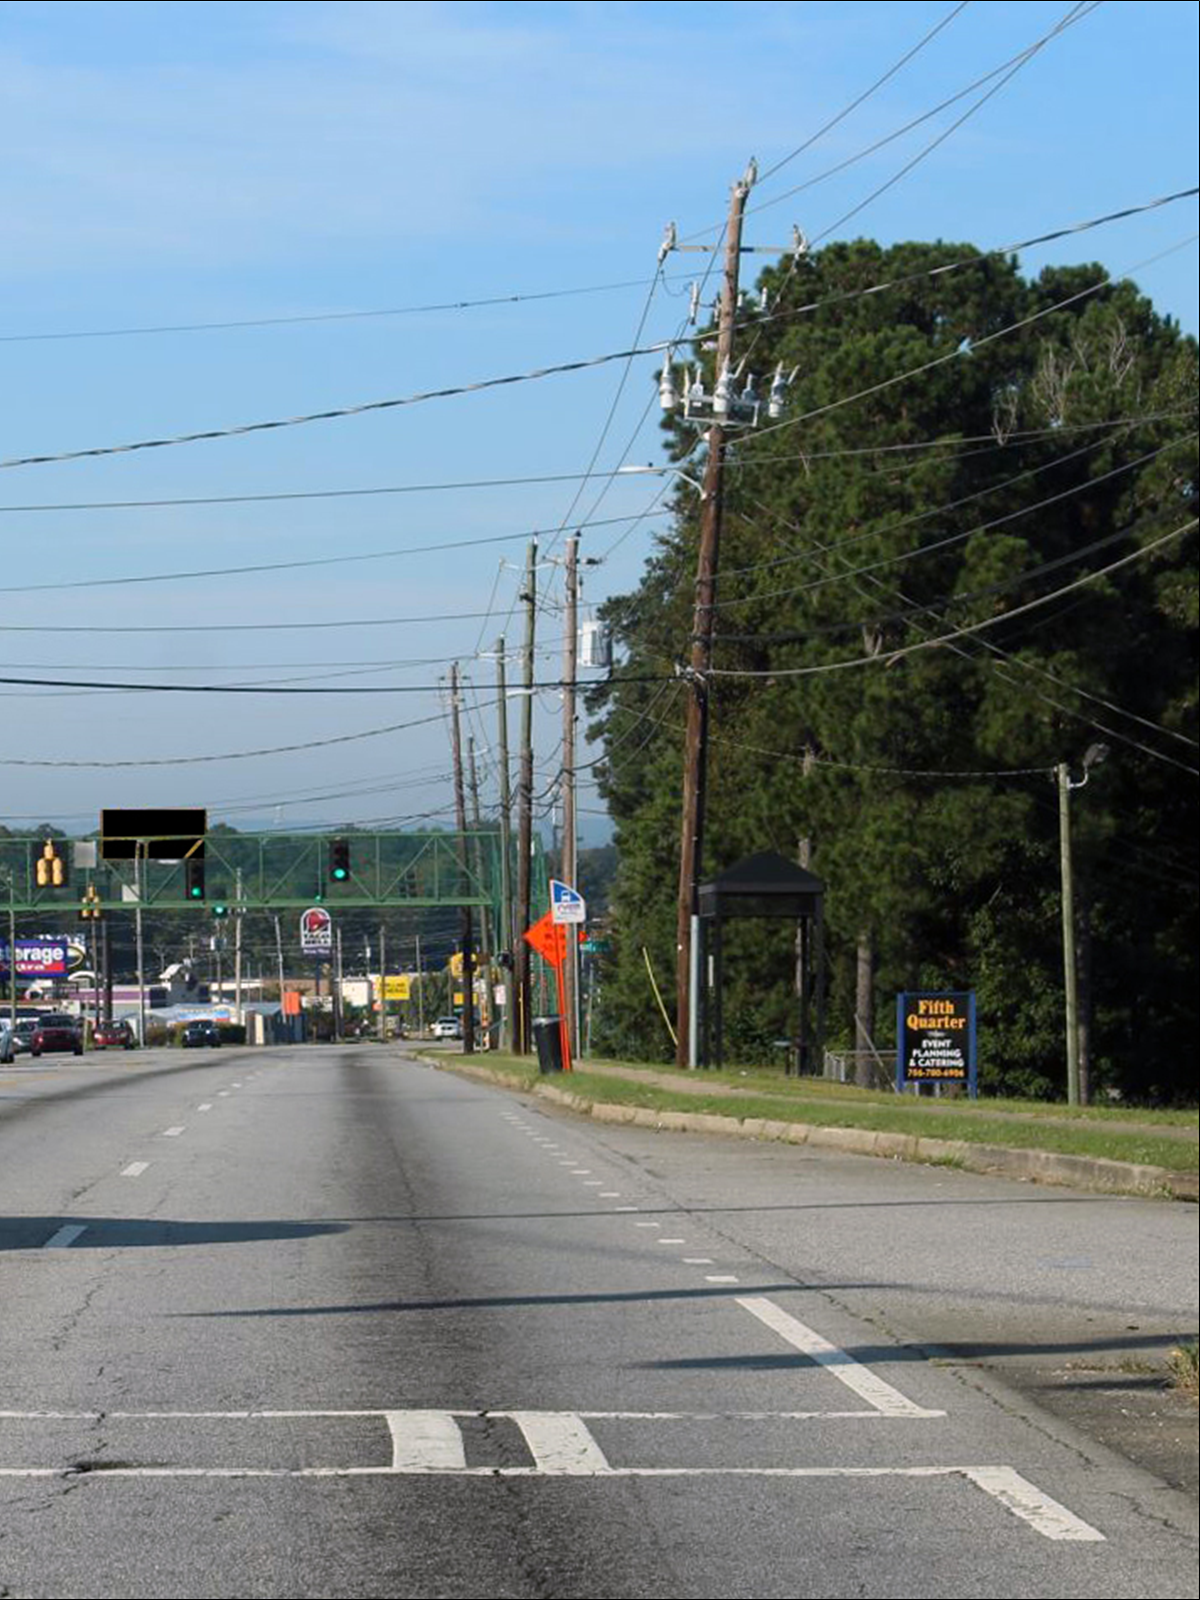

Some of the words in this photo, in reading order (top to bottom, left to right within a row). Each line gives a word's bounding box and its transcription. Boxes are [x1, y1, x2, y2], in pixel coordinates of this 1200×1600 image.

[918, 999, 955, 1014] Fifth
[906, 1014, 966, 1031] Quarter
[921, 1039, 952, 1048] EVENT
[912, 1049, 961, 1058] PLANNING
[918, 1058, 964, 1067] CATERING
